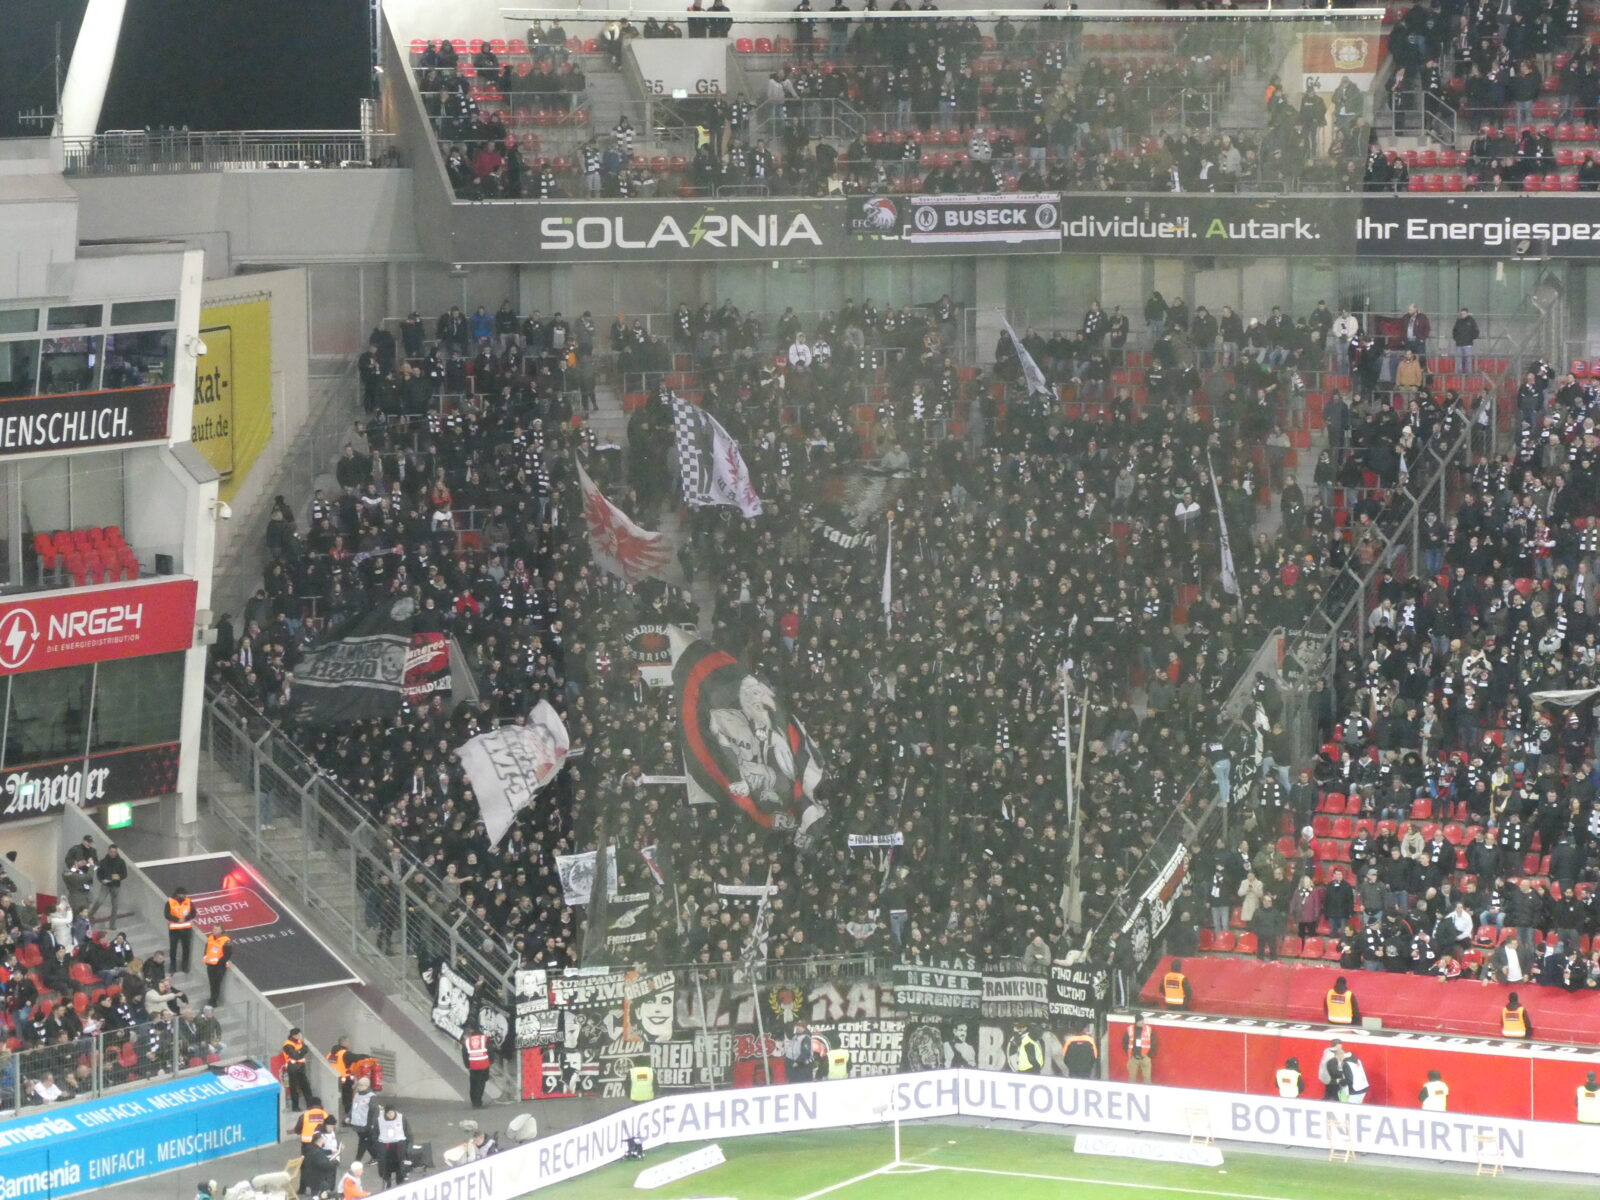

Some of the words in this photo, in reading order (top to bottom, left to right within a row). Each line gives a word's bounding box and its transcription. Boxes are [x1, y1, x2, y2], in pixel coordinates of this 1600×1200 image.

[695, 79, 719, 94] G5
[852, 219, 870, 229] EFC
[944, 208, 1027, 227] BUSECK
[1061, 216, 1198, 239] ndividuell.
[1205, 217, 1321, 240] Autark.
[1356, 216, 1399, 240] Ihr
[540, 213, 823, 250] SOLARNIA
[194, 366, 228, 405] kat-
[191, 414, 229, 443] auft.de
[48, 603, 143, 641] NRG24
[46, 644, 60, 653] DIE
[61, 633, 141, 651] ENERGIEDISTRIBUTION
[4, 765, 110, 815] Anzeiger
[196, 900, 249, 916] ENROTH
[194, 914, 233, 927] WARE
[907, 971, 970, 990] NEVER
[1051, 966, 1072, 982] FINO
[897, 991, 980, 1009] SURRENDER
[1050, 1003, 1095, 1019] ESTREMISTA
[839, 1033, 904, 1049] GRUPPE
[650, 1043, 694, 1069] RIED
[654, 1068, 693, 1085] EBIET
[897, 1077, 1151, 1122] SCHULTOUREN
[0, 1117, 76, 1147] armenia
[539, 1091, 818, 1179] RECHNUNGSFAHRTEN
[1231, 1101, 1525, 1159] BOTENFAHRTEN
[157, 1124, 246, 1163] MENSCHLICH.
